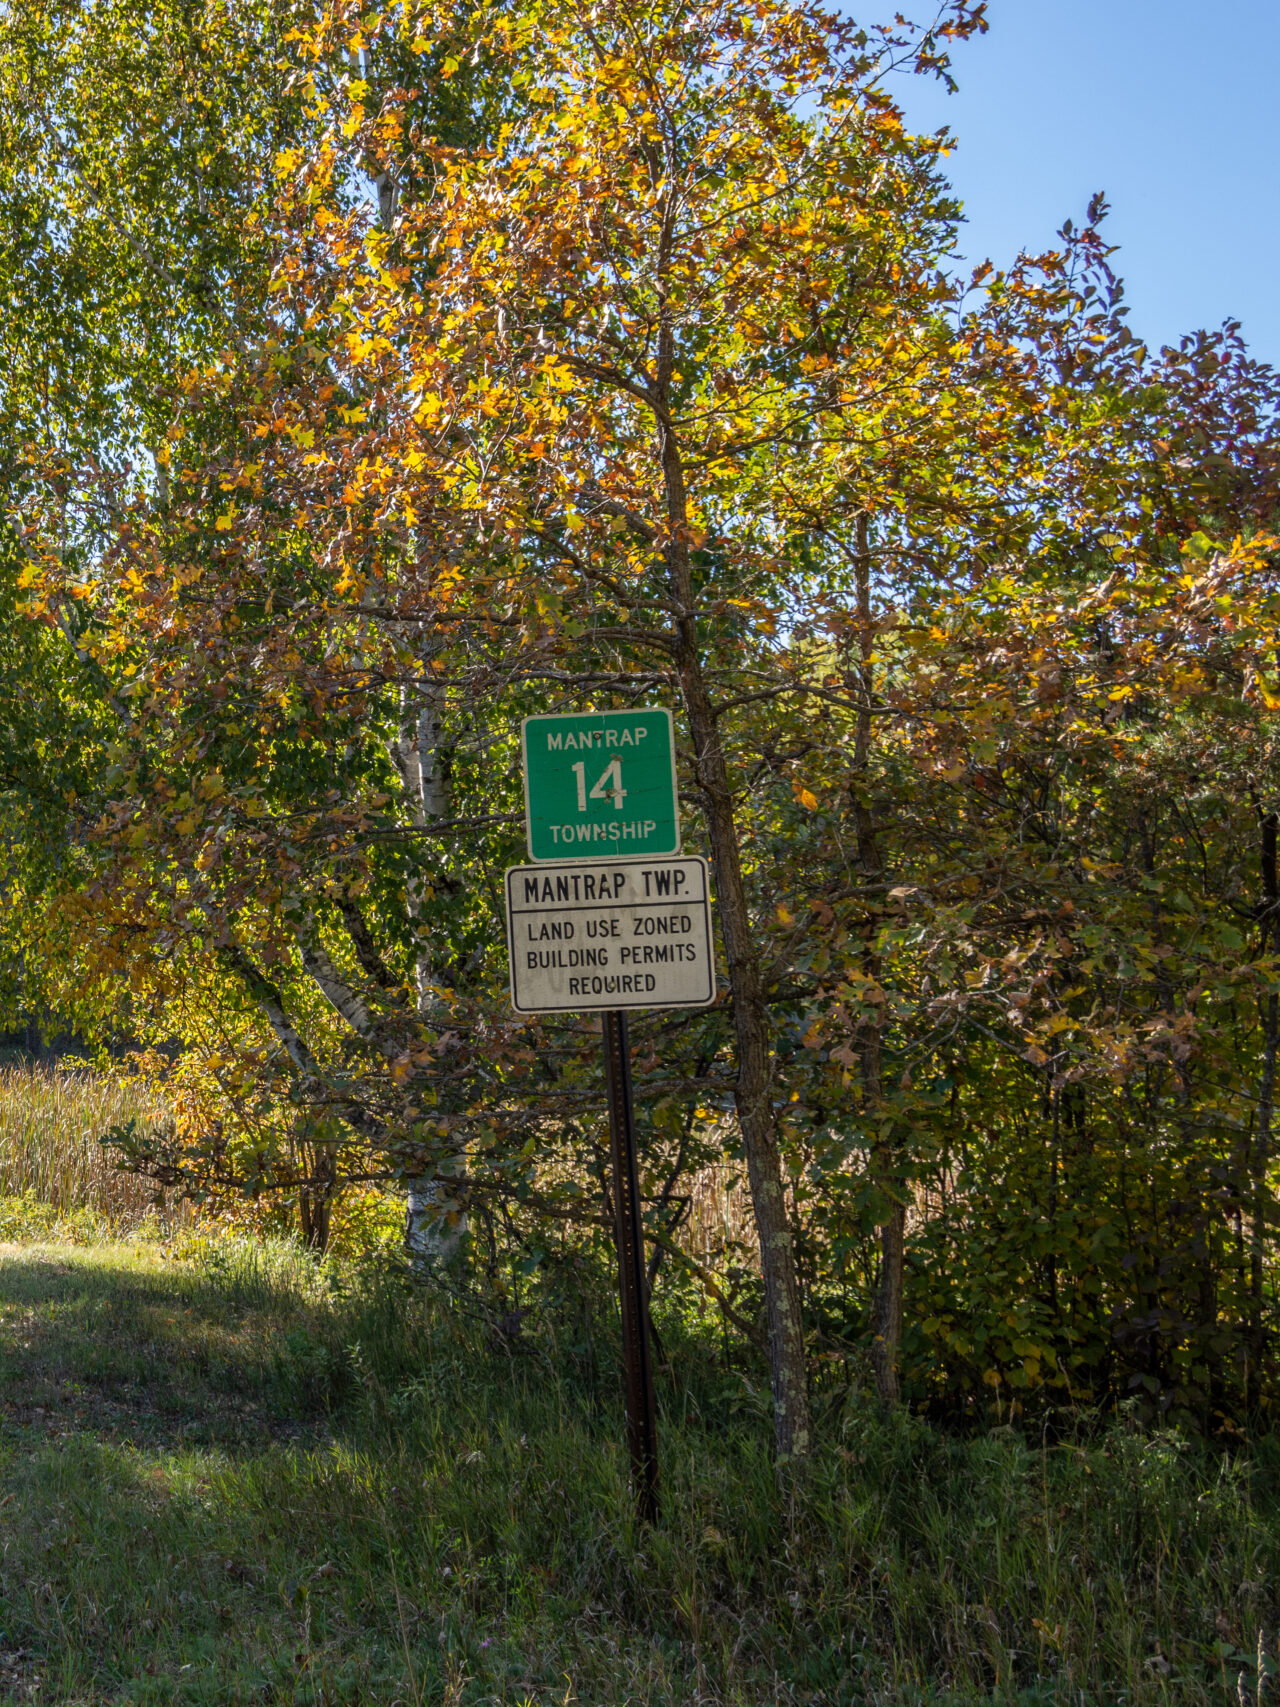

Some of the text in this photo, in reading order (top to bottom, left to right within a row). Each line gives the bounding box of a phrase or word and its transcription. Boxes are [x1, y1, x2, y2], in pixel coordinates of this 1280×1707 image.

[547, 727, 648, 751] MANTRAP
[571, 757, 628, 811] 14
[549, 820, 657, 844] TOWNSHIP
[524, 869, 690, 903] MANTRAP TWP.
[527, 915, 692, 941] LAND USE ZONED
[527, 943, 697, 969] BUILDING PERMITS
[569, 974, 656, 996] REQUIRED
